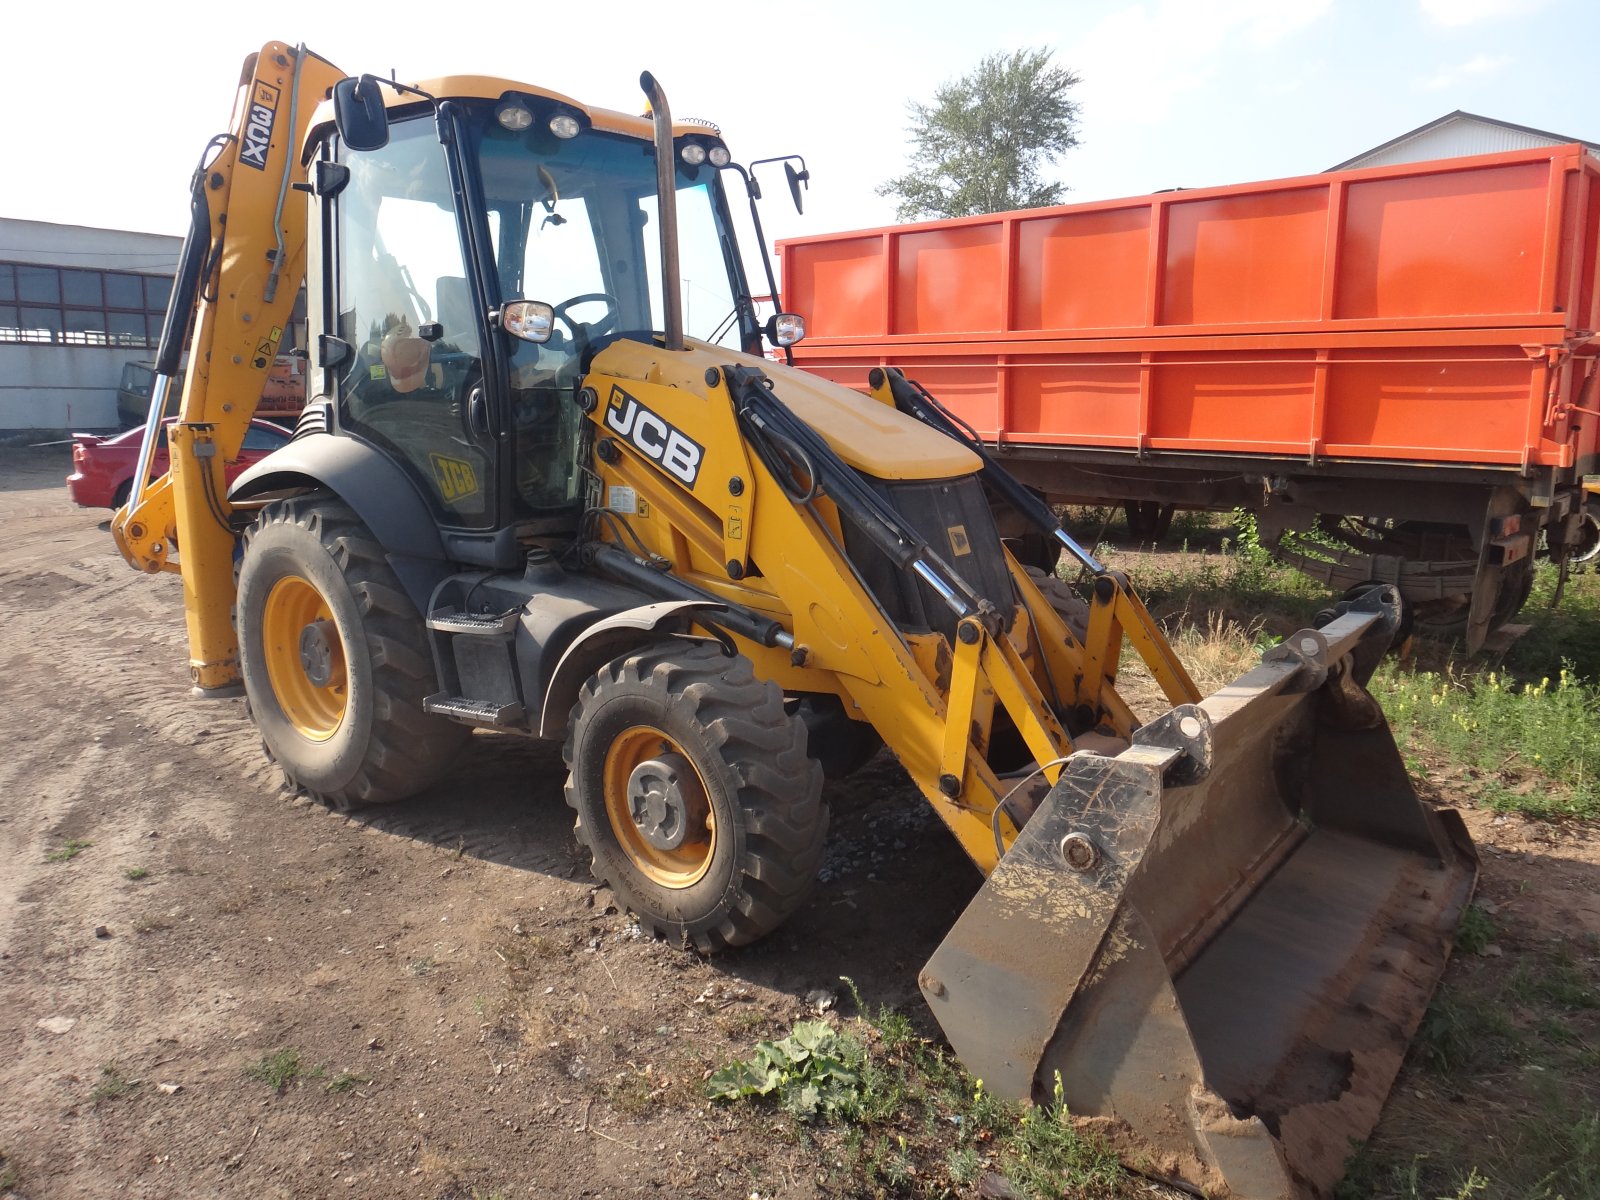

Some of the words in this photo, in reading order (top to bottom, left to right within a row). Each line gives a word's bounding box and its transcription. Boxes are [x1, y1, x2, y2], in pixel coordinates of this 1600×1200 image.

[242, 105, 273, 163] 3CX
[607, 400, 700, 483] JCB
[437, 458, 476, 499] JCB
